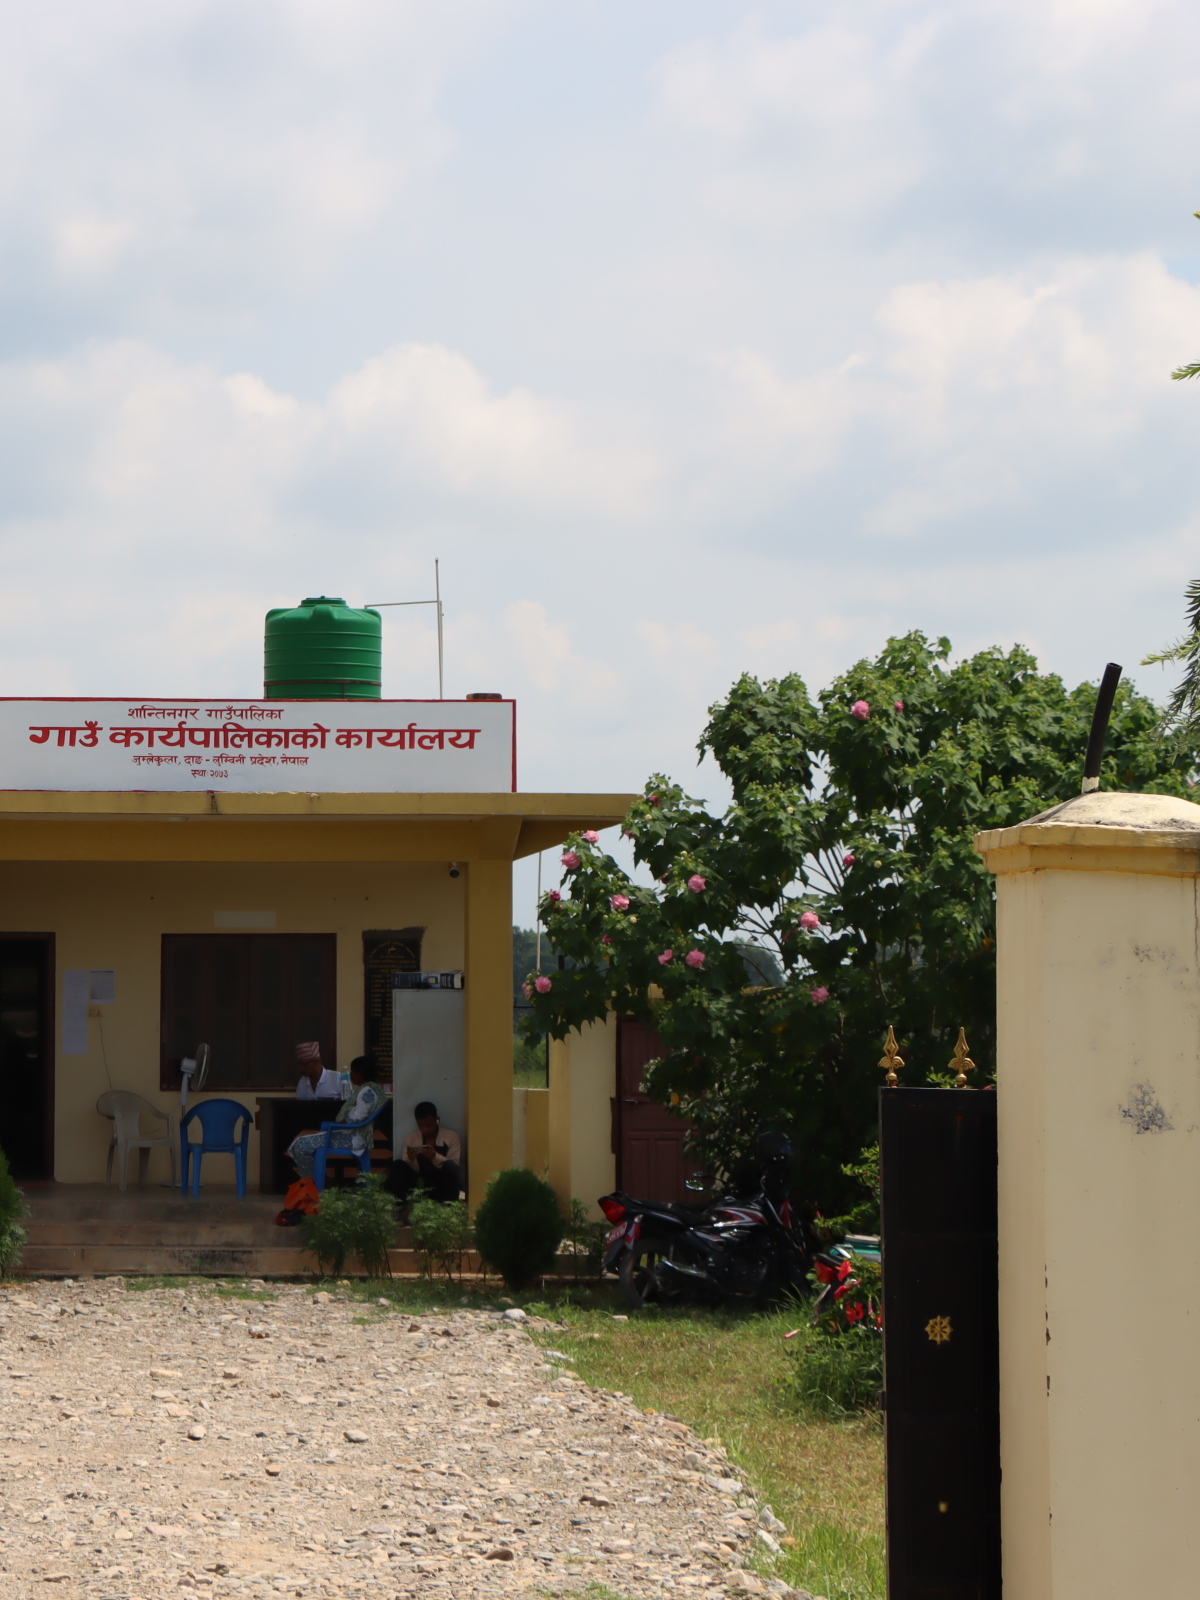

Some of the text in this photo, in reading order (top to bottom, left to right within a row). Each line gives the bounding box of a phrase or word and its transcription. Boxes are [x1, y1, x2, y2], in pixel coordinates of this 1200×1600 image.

[127, 704, 285, 721] शान्तिनगर गाउँपालिका
[29, 720, 482, 750] गाउँ कार्यपालिकाको कार्यालय
[280, 753, 310, 766] नेपाल
